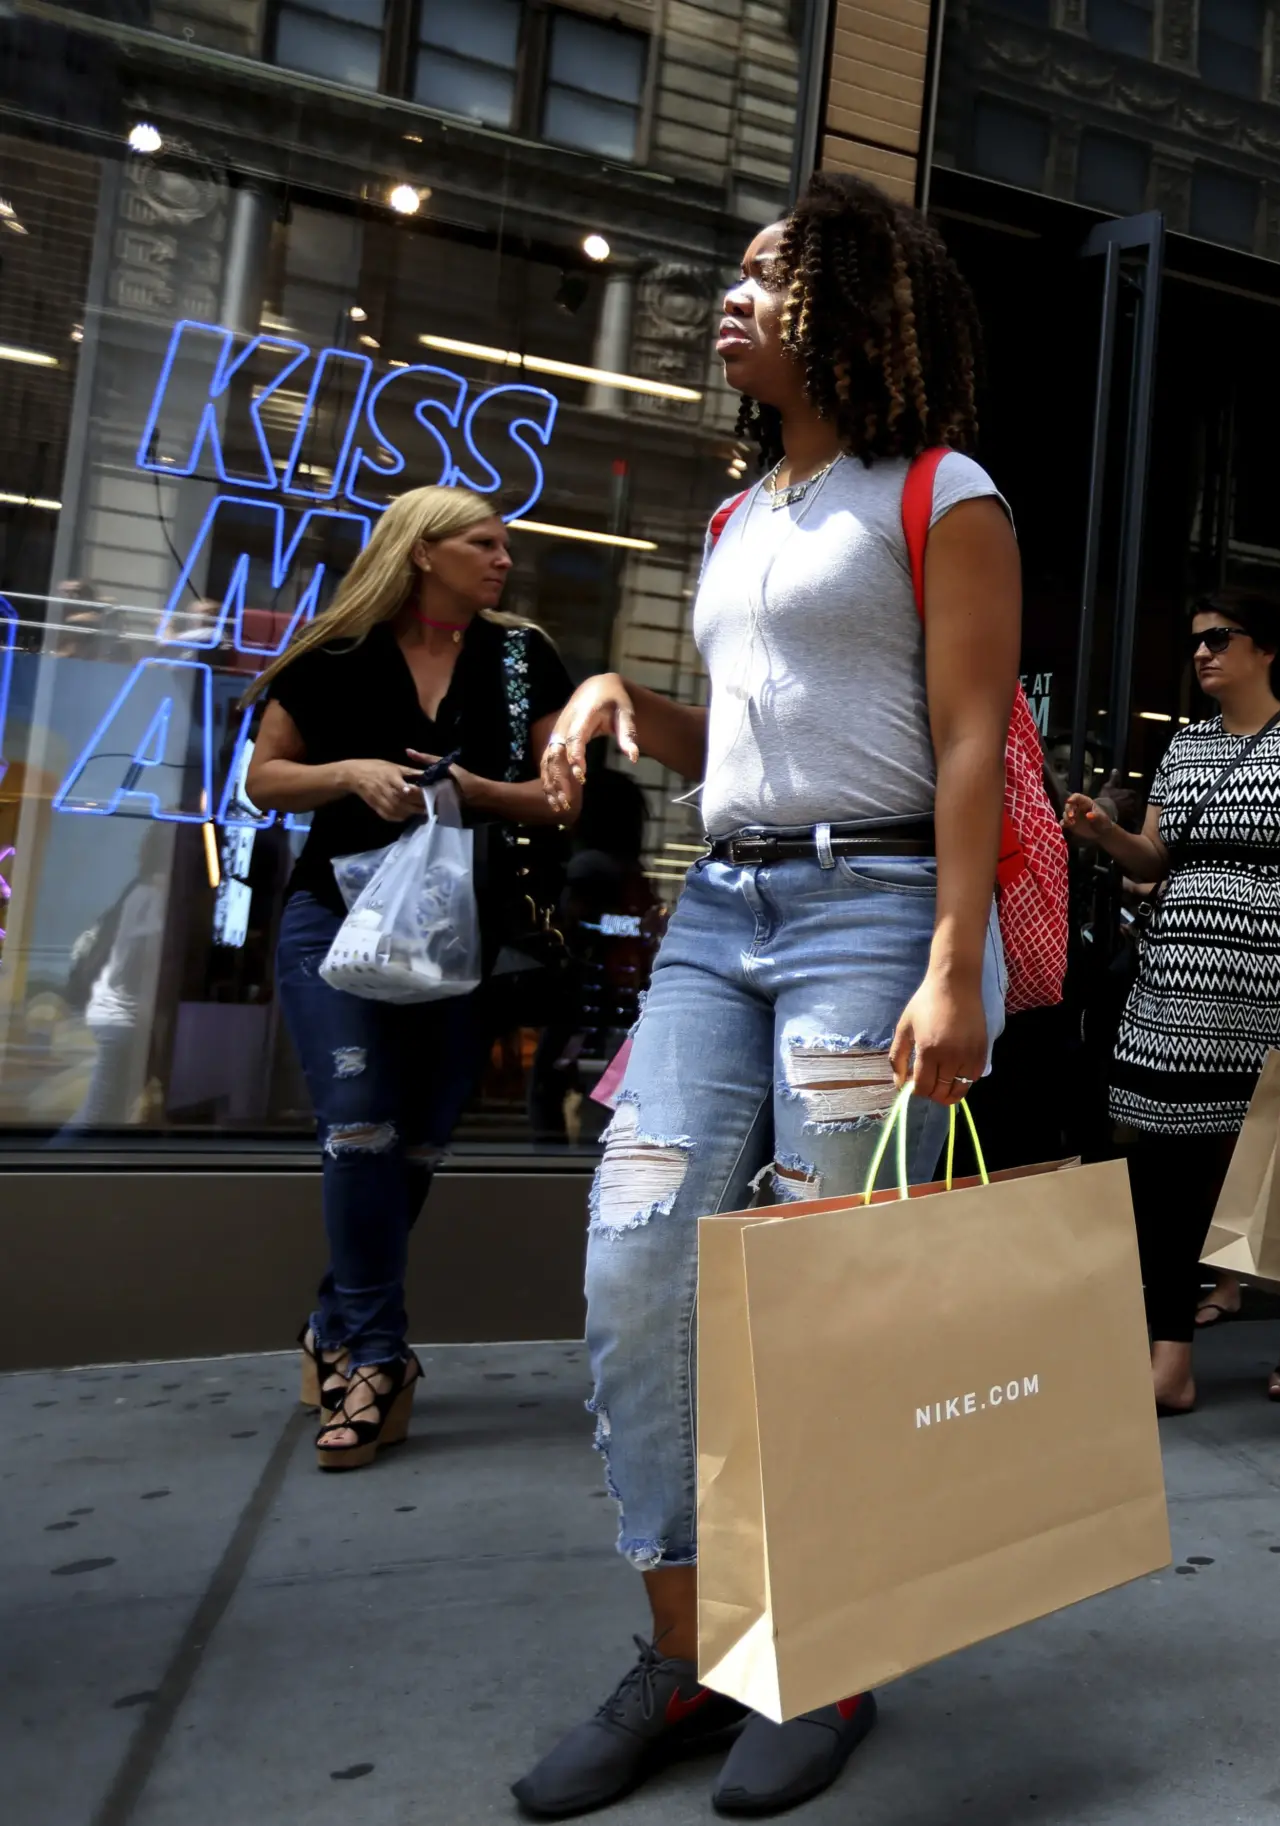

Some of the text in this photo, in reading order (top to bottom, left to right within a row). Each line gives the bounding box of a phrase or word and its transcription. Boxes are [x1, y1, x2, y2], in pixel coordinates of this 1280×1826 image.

[138, 320, 558, 522] KISS
[1032, 673, 1053, 695] AT
[916, 1374, 1039, 1428] NIKE.COM
